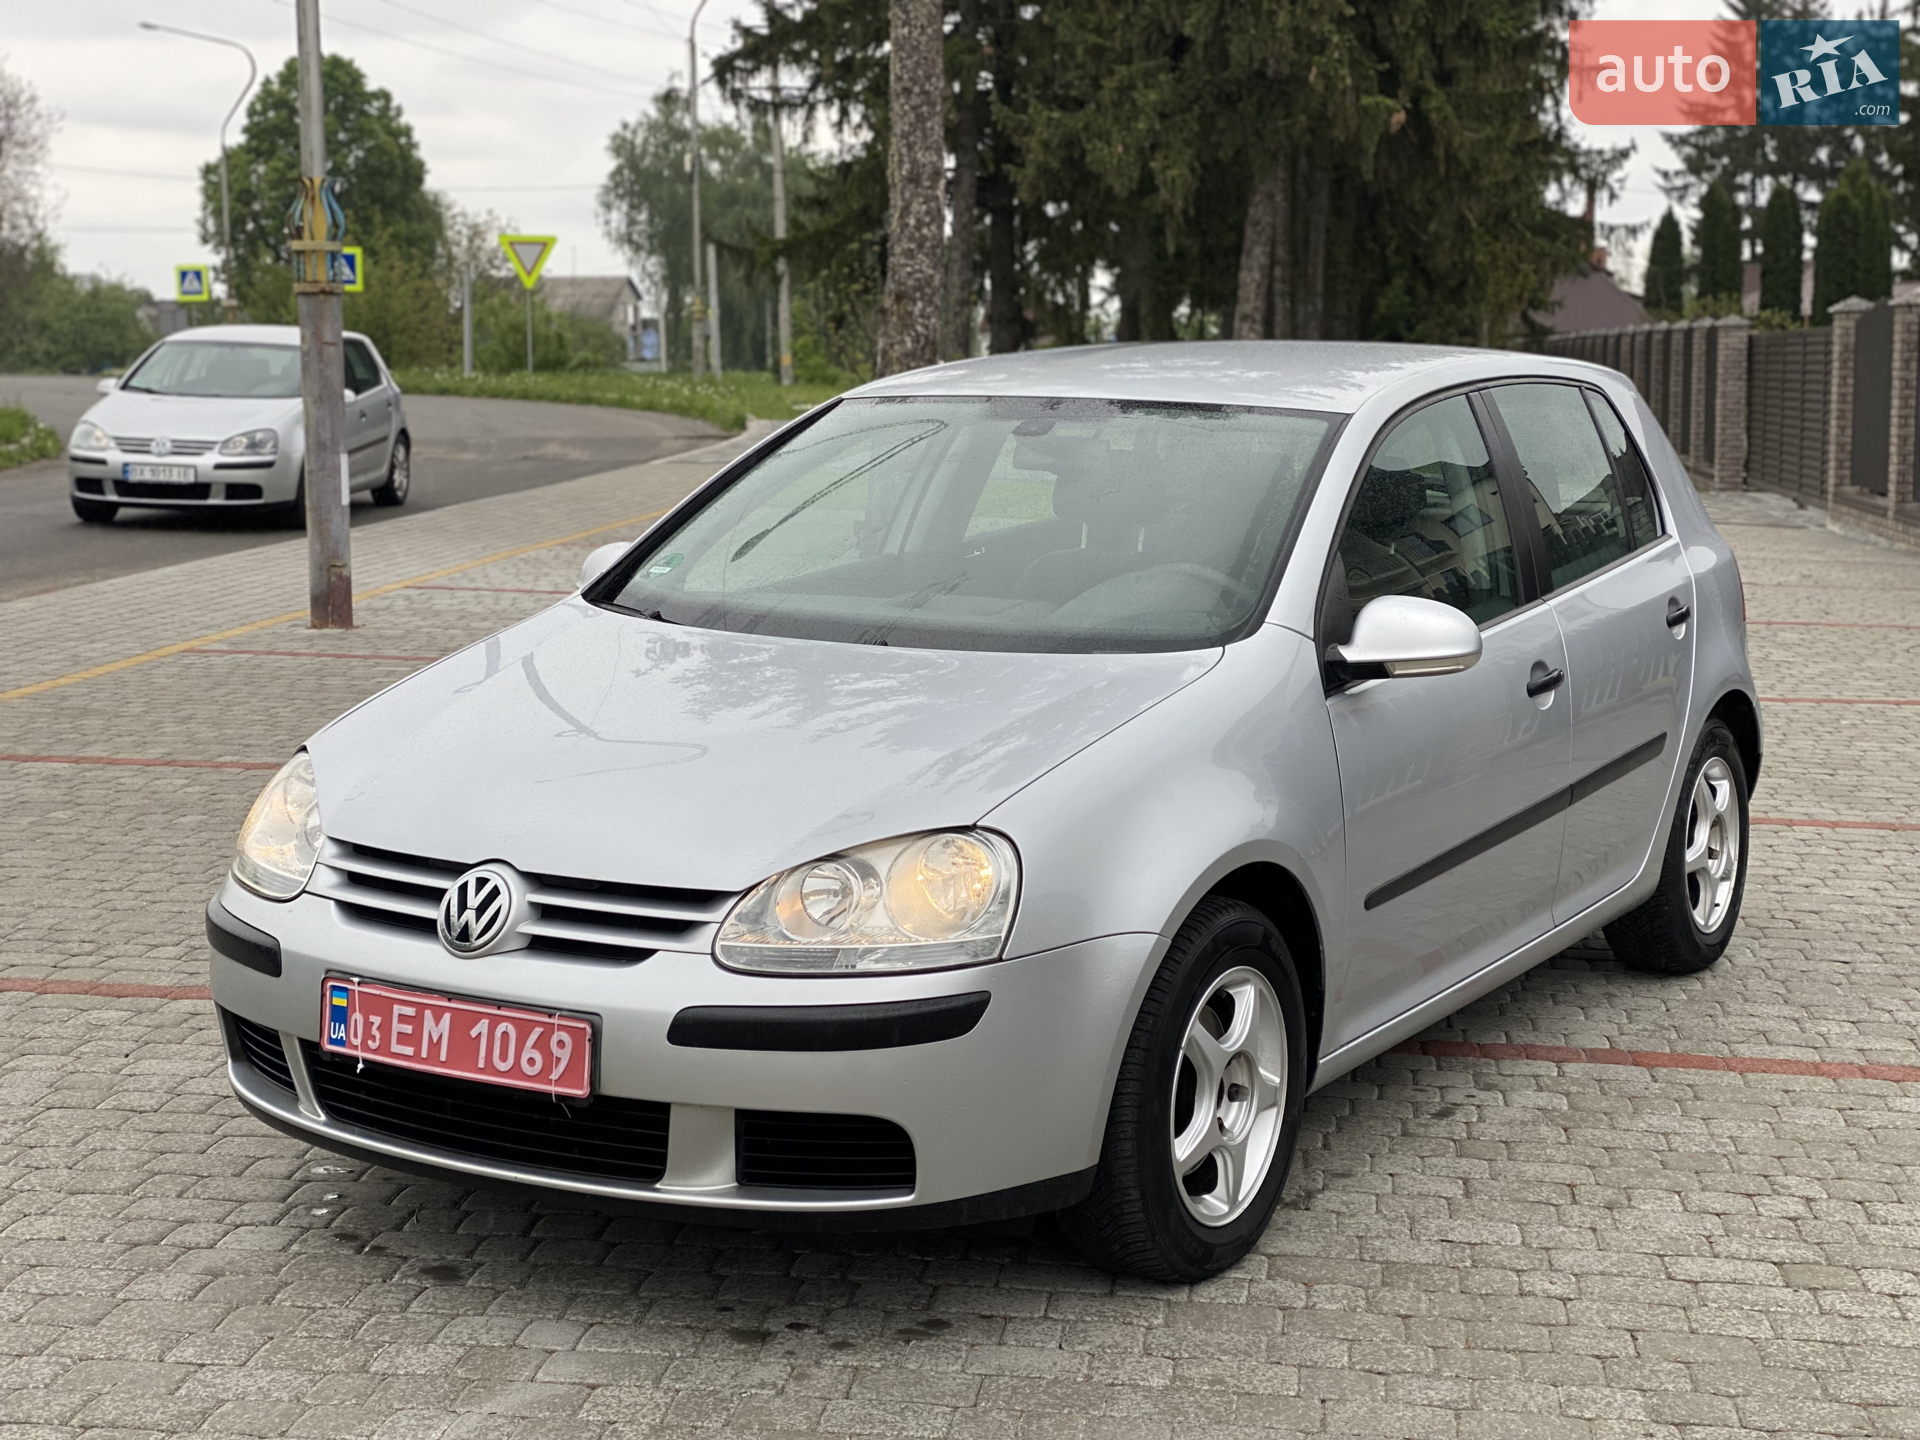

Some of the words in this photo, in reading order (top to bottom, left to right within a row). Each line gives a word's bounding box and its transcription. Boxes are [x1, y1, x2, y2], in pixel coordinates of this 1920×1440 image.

[330, 1021, 347, 1041] UA
[350, 1012, 382, 1051] 03
[390, 1004, 452, 1063] EM
[469, 1018, 573, 1081] 1069
